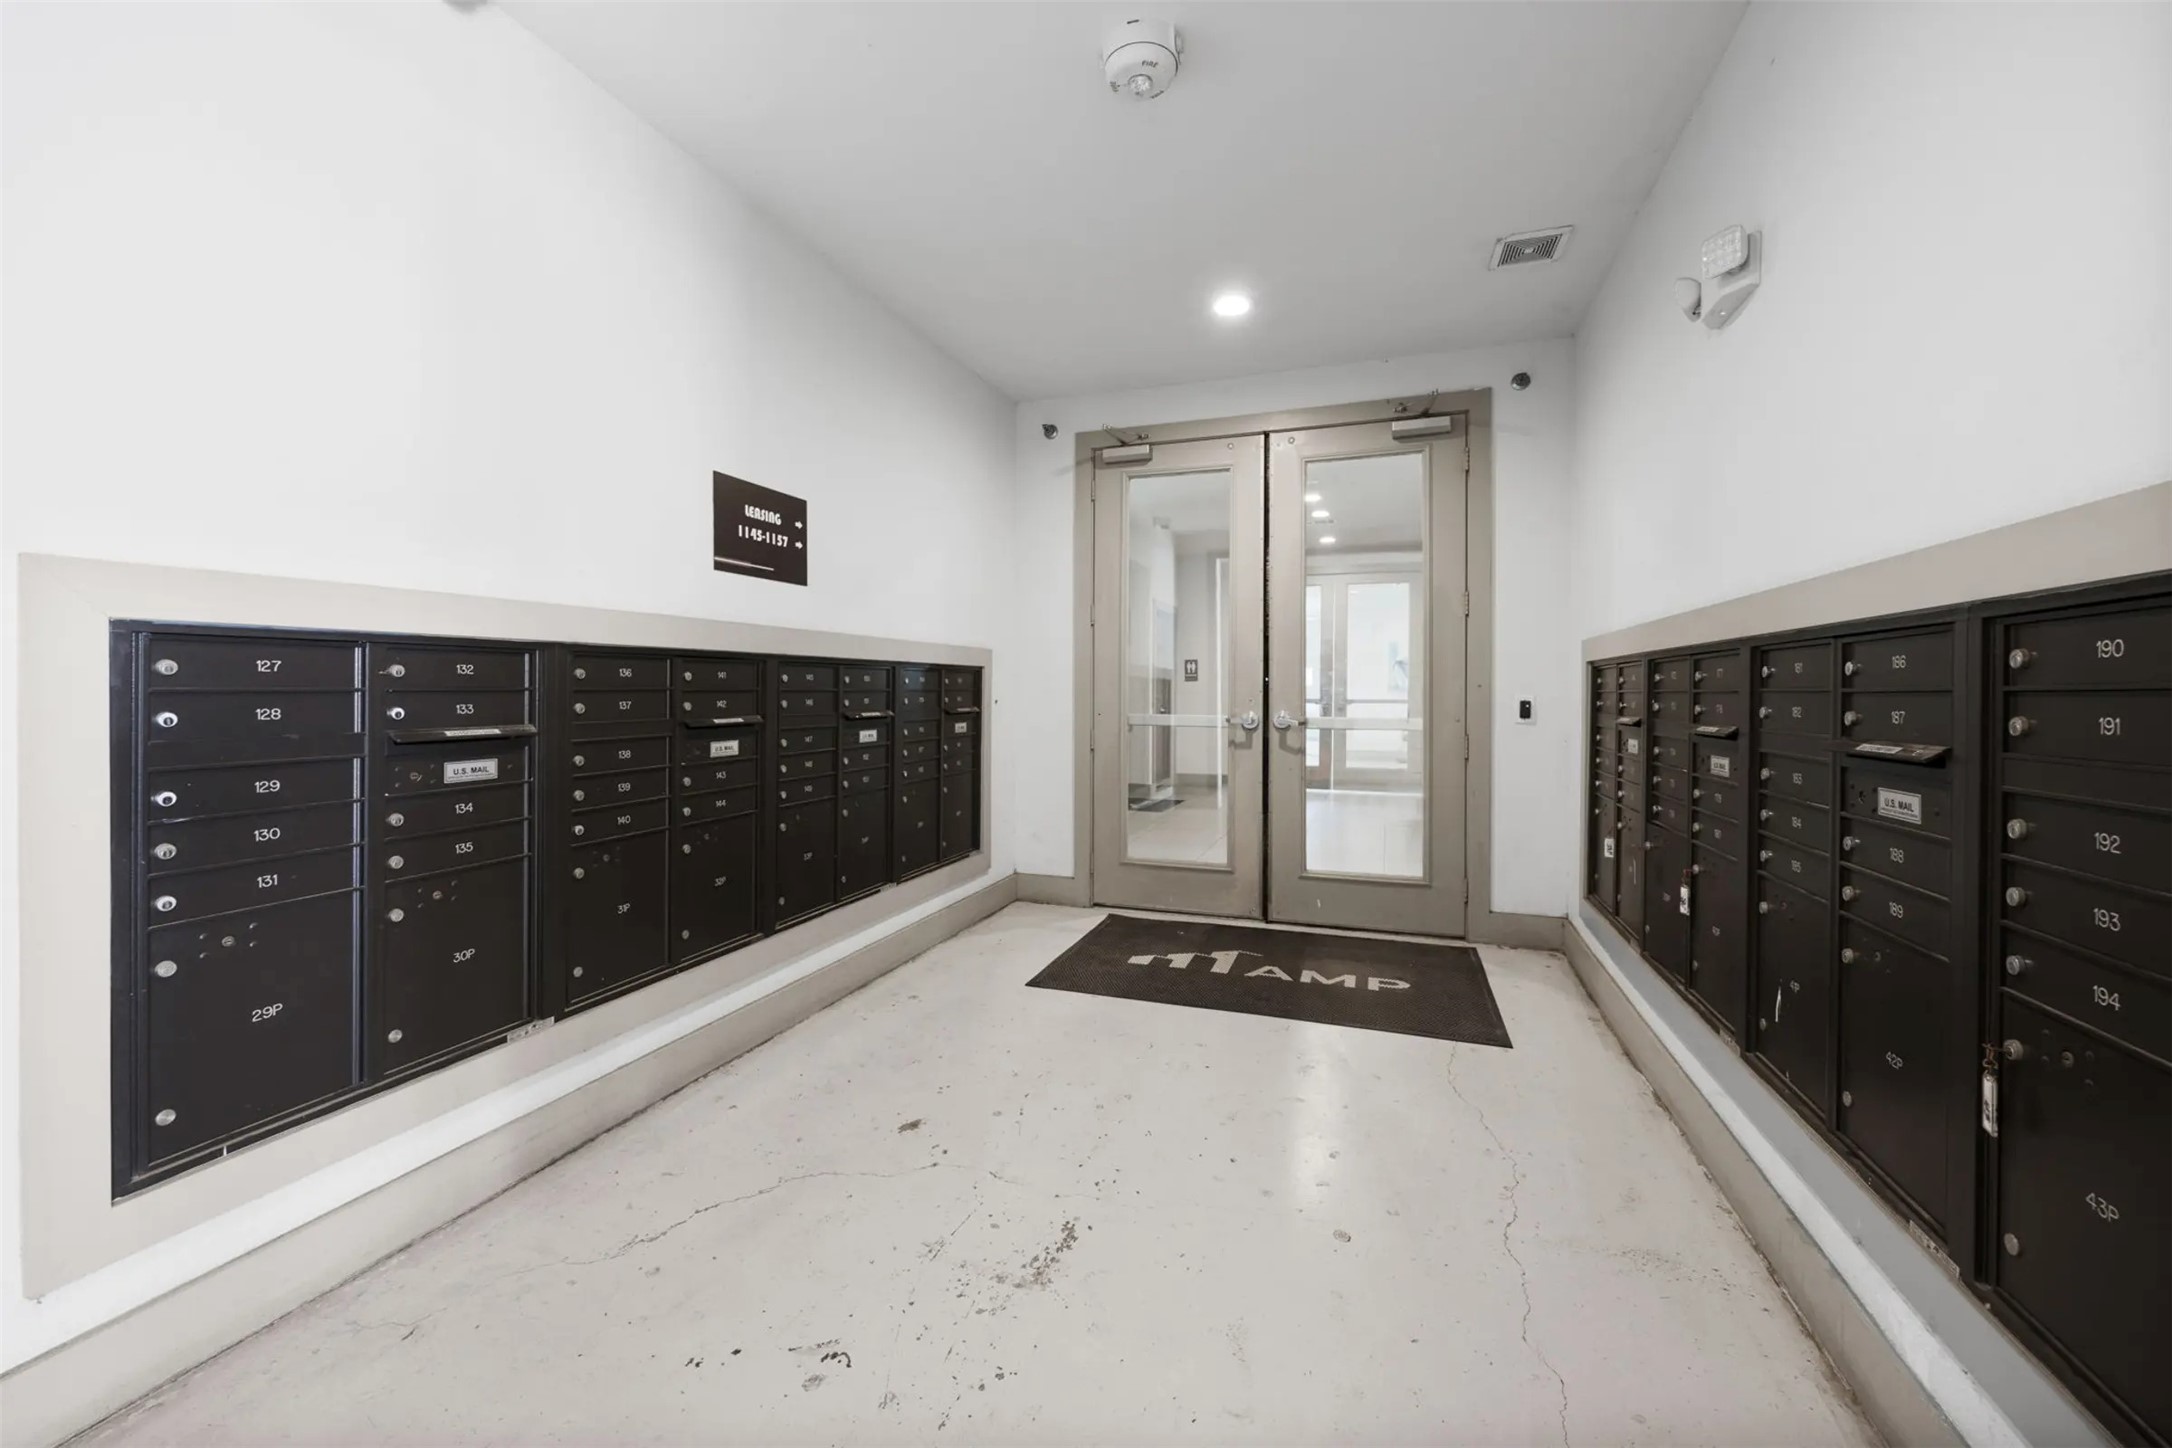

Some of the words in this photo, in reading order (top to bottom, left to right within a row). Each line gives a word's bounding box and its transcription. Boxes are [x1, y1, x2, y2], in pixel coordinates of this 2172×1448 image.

[744, 504, 782, 525] LEASING
[738, 524, 789, 548] 1145-1157
[2095, 638, 2125, 658] 190
[255, 659, 282, 673] 127
[1891, 654, 1907, 669] 186
[456, 664, 475, 675] 132
[618, 667, 633, 678] 136
[455, 703, 475, 715] 133
[618, 700, 632, 710] 137
[255, 707, 282, 721] 128
[1891, 710, 1906, 725] 187
[2098, 716, 2121, 736] 191
[618, 749, 632, 759] 138
[452, 767, 469, 776] U.S.
[470, 766, 490, 774] MAIL
[715, 770, 727, 780] 143
[254, 779, 281, 794] 129
[617, 782, 631, 793] 139
[455, 802, 474, 815] 134
[1883, 797, 1896, 808] U.S.
[1897, 801, 1915, 813] MAIL
[617, 814, 631, 825] 140
[253, 827, 281, 842] 130
[455, 841, 474, 854] 135
[2094, 832, 2121, 855] 192
[1889, 847, 1905, 864] 188
[256, 873, 278, 889] 131
[617, 902, 631, 914] 31P
[1888, 901, 1904, 919] 189
[2093, 907, 2121, 932] 193
[452, 948, 476, 963] 30P
[1244, 964, 1411, 992] AMP
[2092, 984, 2121, 1011] 194
[251, 1002, 284, 1023] 29P
[2085, 1192, 2120, 1222] 43P
